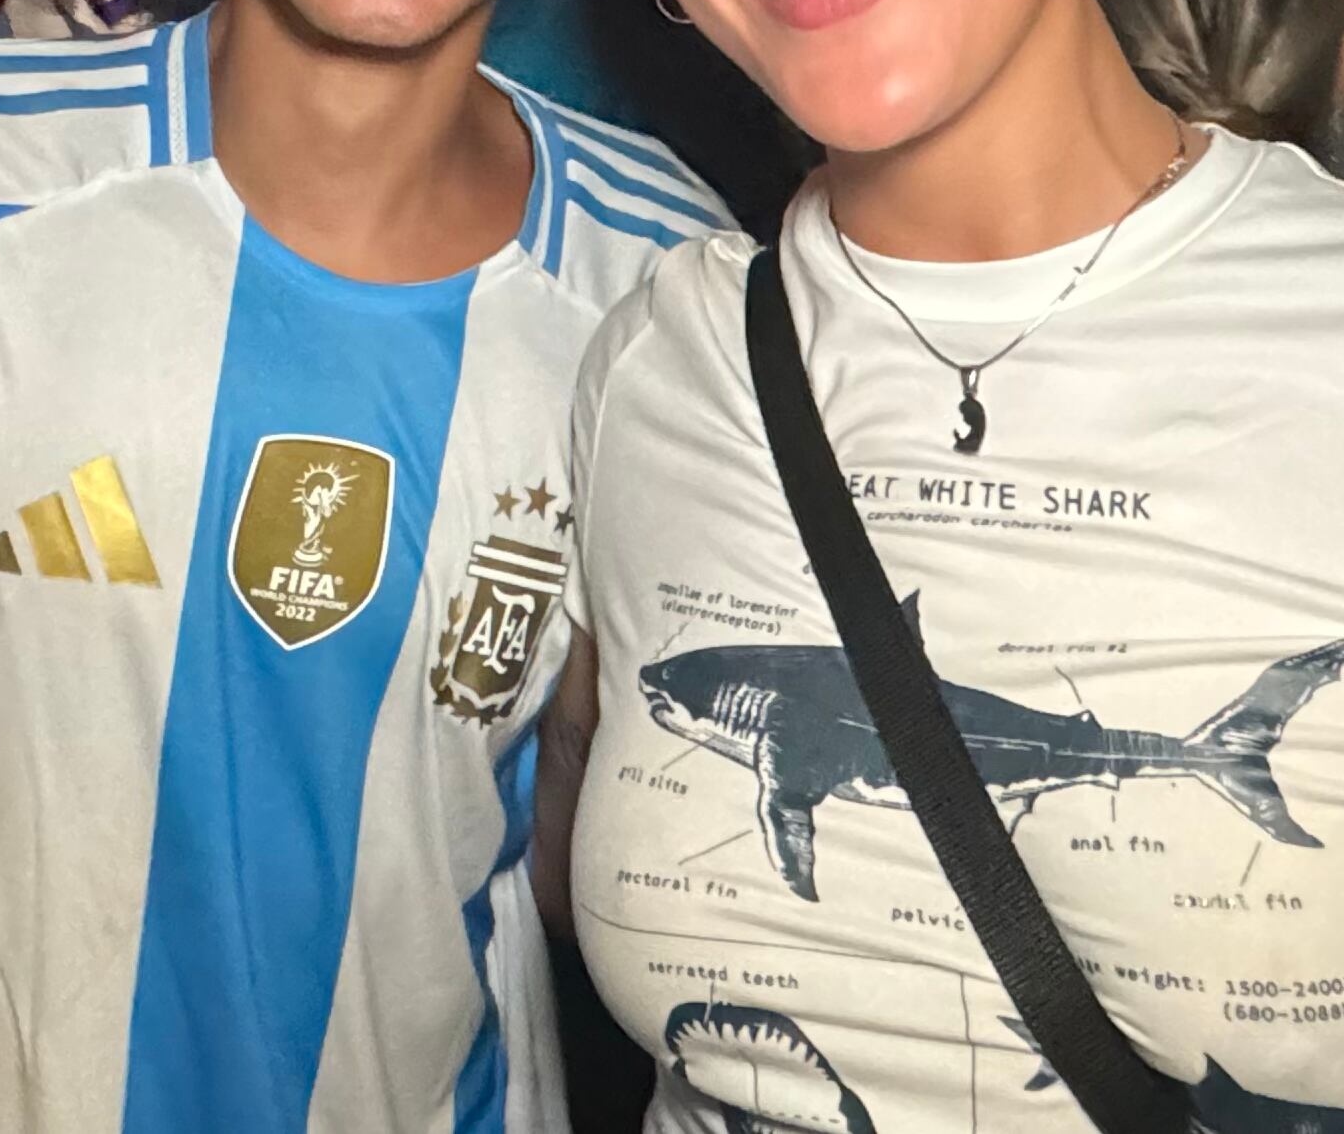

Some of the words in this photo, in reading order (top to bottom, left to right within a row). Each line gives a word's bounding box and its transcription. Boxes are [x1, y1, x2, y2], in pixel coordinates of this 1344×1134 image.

[919, 478, 1016, 510] WHITE
[1043, 486, 1151, 520] SHARK
[269, 566, 335, 599] FIFA
[707, 592, 723, 604] of
[275, 602, 316, 622] 2022
[1070, 835, 1115, 853] anal
[1129, 836, 1166, 854] fin
[617, 869, 691, 893] pectoral
[706, 881, 738, 900] fin
[1266, 893, 1303, 910] fin
[891, 907, 965, 933] pelvic
[648, 960, 728, 982] serrated
[742, 970, 799, 990] teeth
[1114, 967, 1205, 993] weight:
